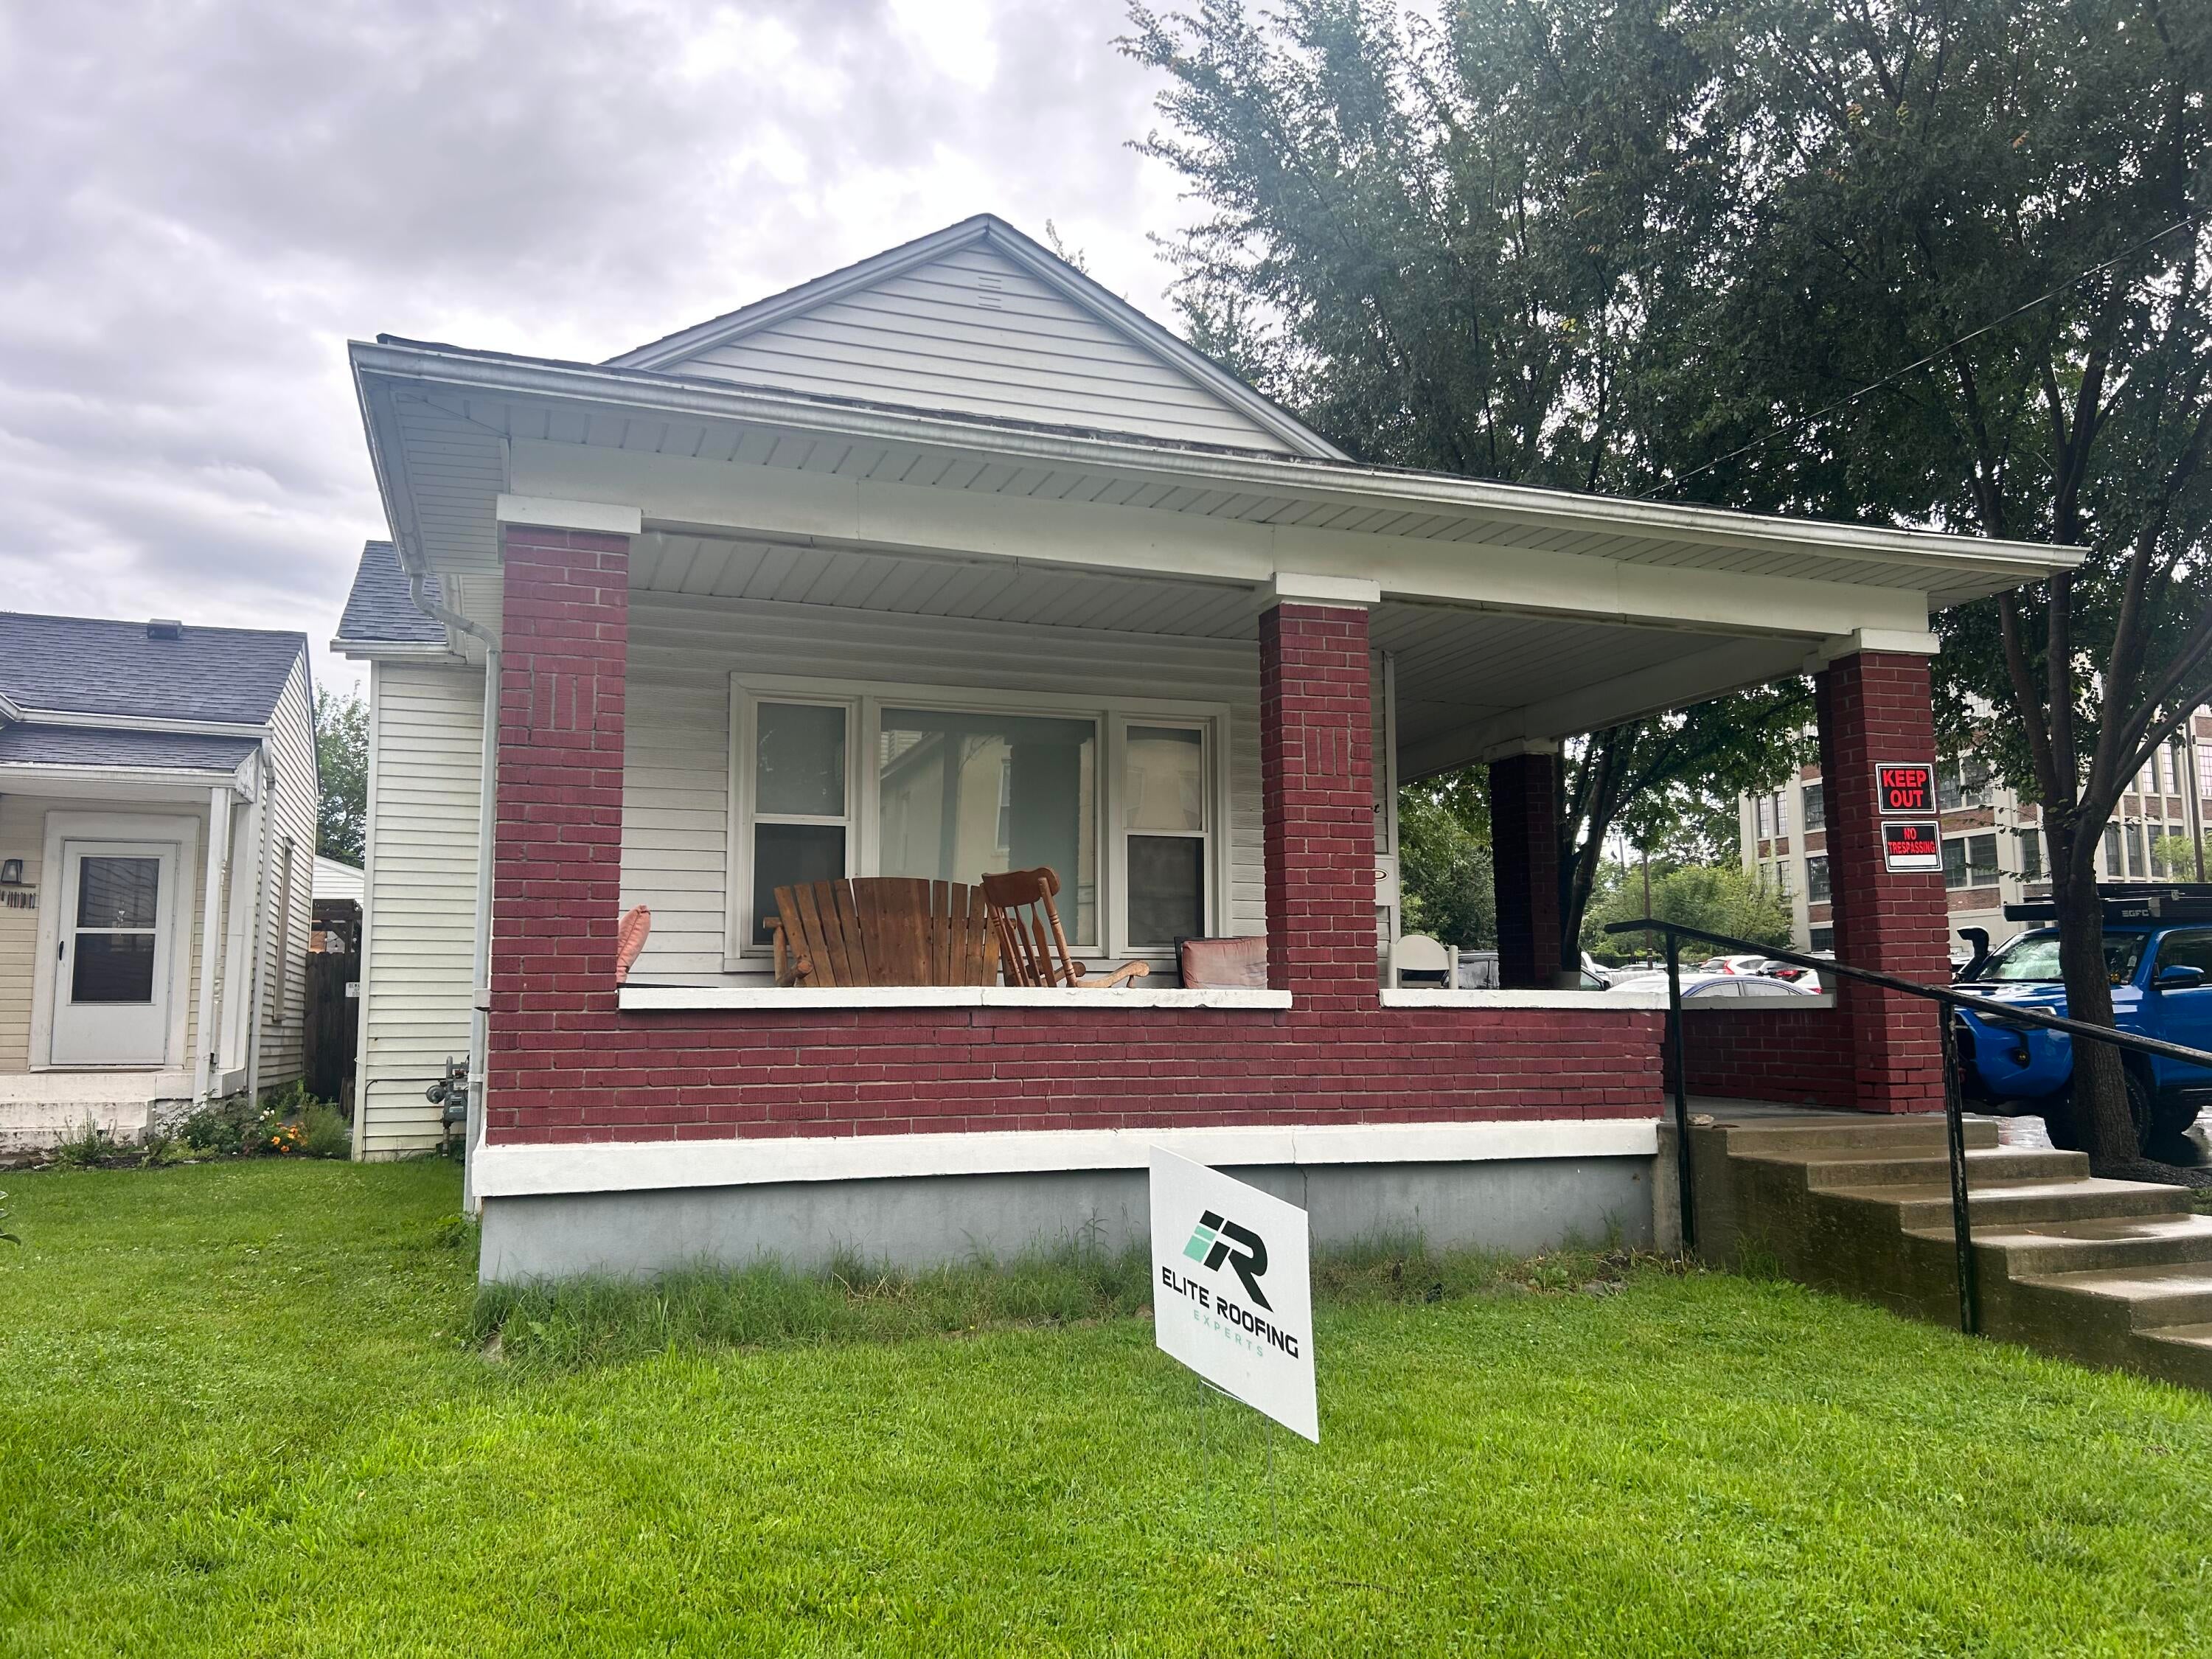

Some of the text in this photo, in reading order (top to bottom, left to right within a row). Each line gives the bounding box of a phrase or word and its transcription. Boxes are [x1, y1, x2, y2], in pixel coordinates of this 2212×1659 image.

[1883, 770, 1927, 787] KEEP
[1890, 790, 1924, 807] OUT
[1903, 827, 1917, 840] NO
[1888, 841, 1936, 855] TRESPASSING
[1162, 1266, 1298, 1359] ELITE ROOFING
[1193, 1310, 1263, 1357] EXPERTS
